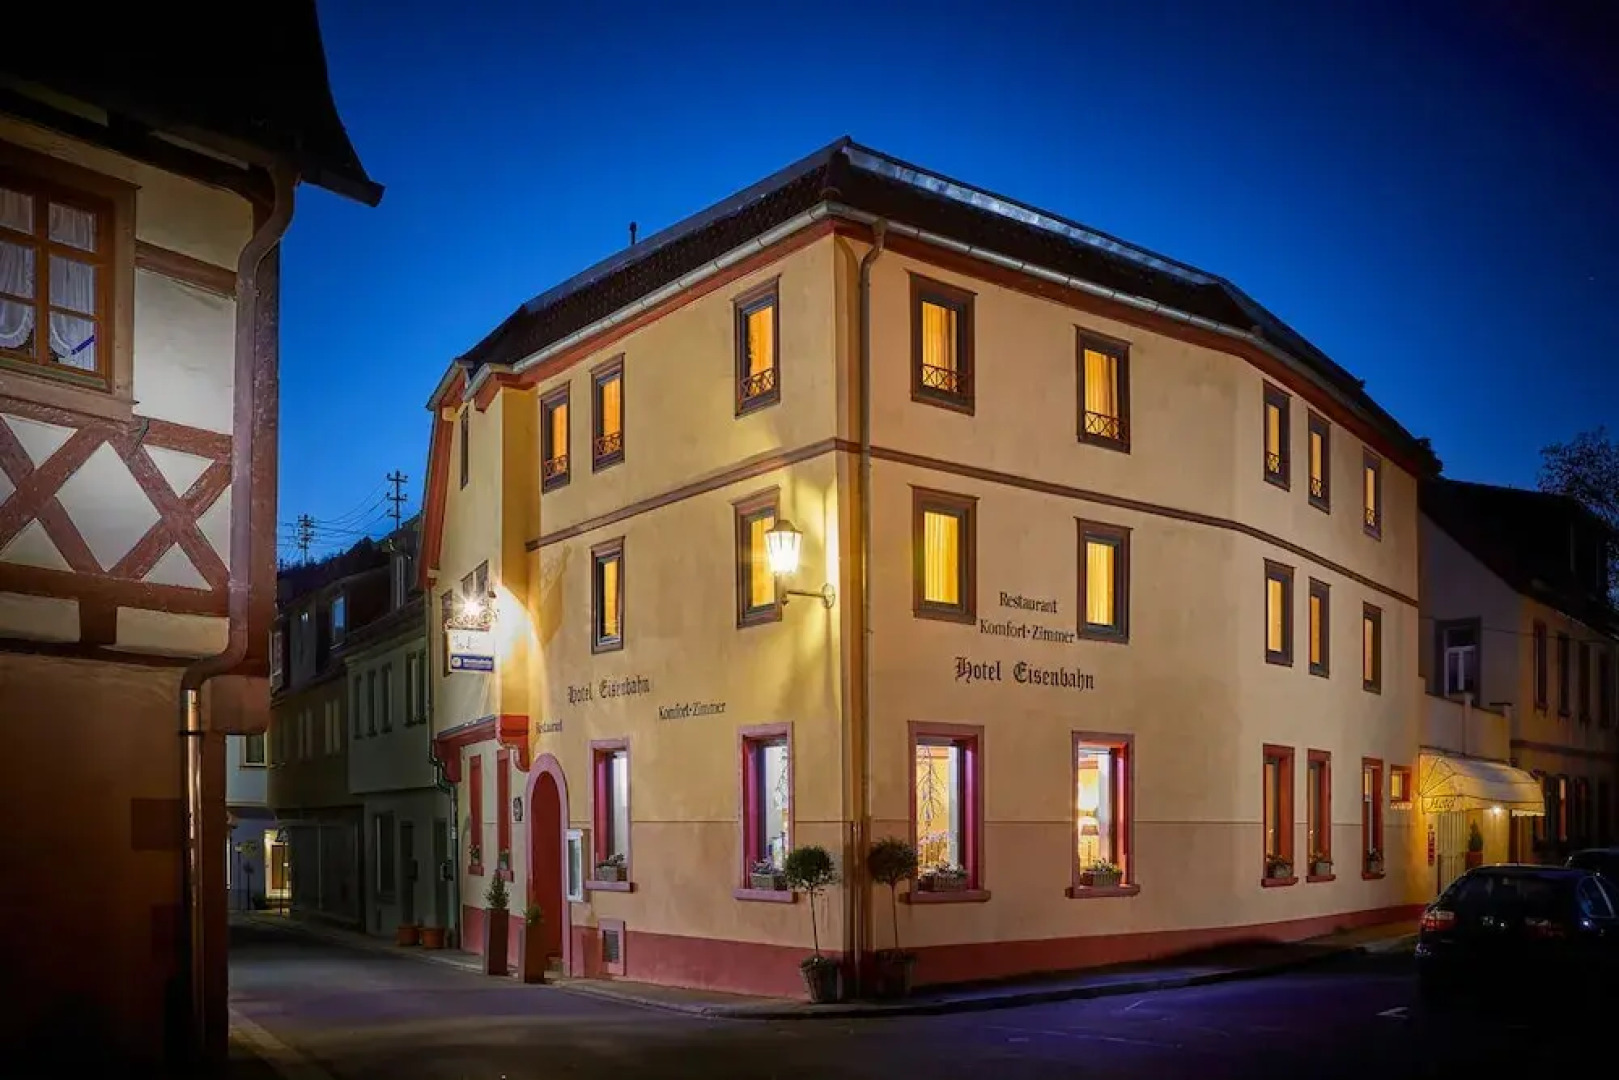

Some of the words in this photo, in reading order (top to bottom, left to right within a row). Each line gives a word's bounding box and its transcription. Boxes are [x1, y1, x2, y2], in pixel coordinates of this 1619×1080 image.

[999, 591, 1058, 614] Restaurant
[954, 656, 1002, 684] Hotel
[1012, 661, 1095, 691] Eisenbahn
[567, 681, 593, 706] Hotel
[599, 675, 650, 699] Eisenbahn
